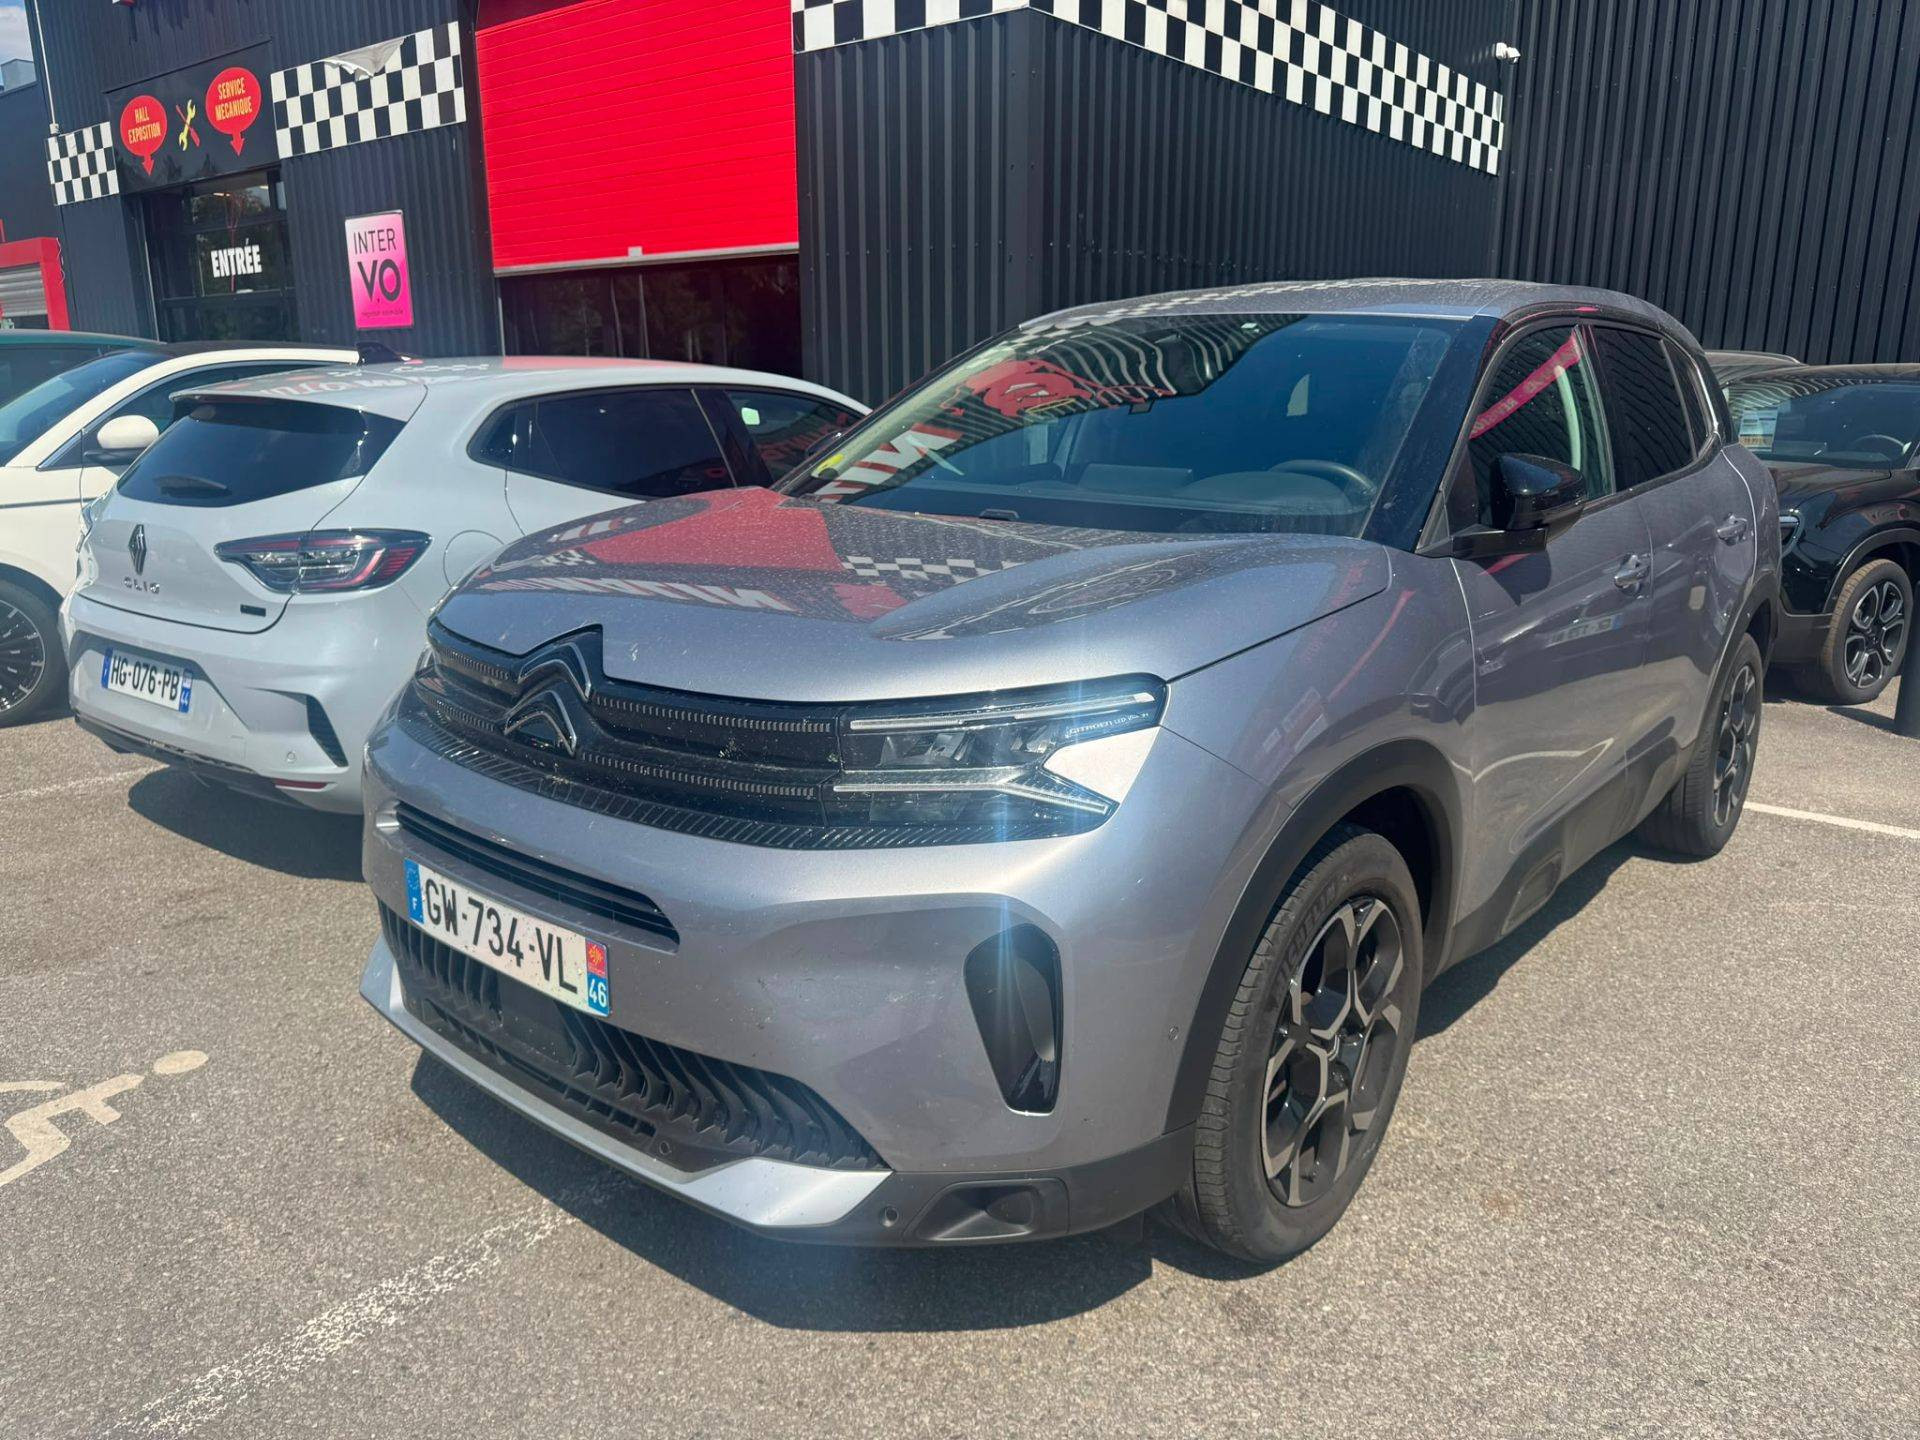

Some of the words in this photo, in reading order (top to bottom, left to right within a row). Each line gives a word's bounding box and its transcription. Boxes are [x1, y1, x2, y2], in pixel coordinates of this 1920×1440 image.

[217, 77, 246, 100] SERVICE
[134, 106, 150, 123] HALL
[127, 121, 162, 144] EXPOSITION
[353, 228, 397, 254] INTER
[210, 237, 262, 278] ENTRÉE
[357, 258, 402, 302] VO
[123, 576, 160, 594] CLIO
[111, 655, 180, 701] HG-076-PB
[412, 896, 418, 910] F
[425, 878, 578, 994] GW-734-VL
[589, 978, 608, 1008] 46
